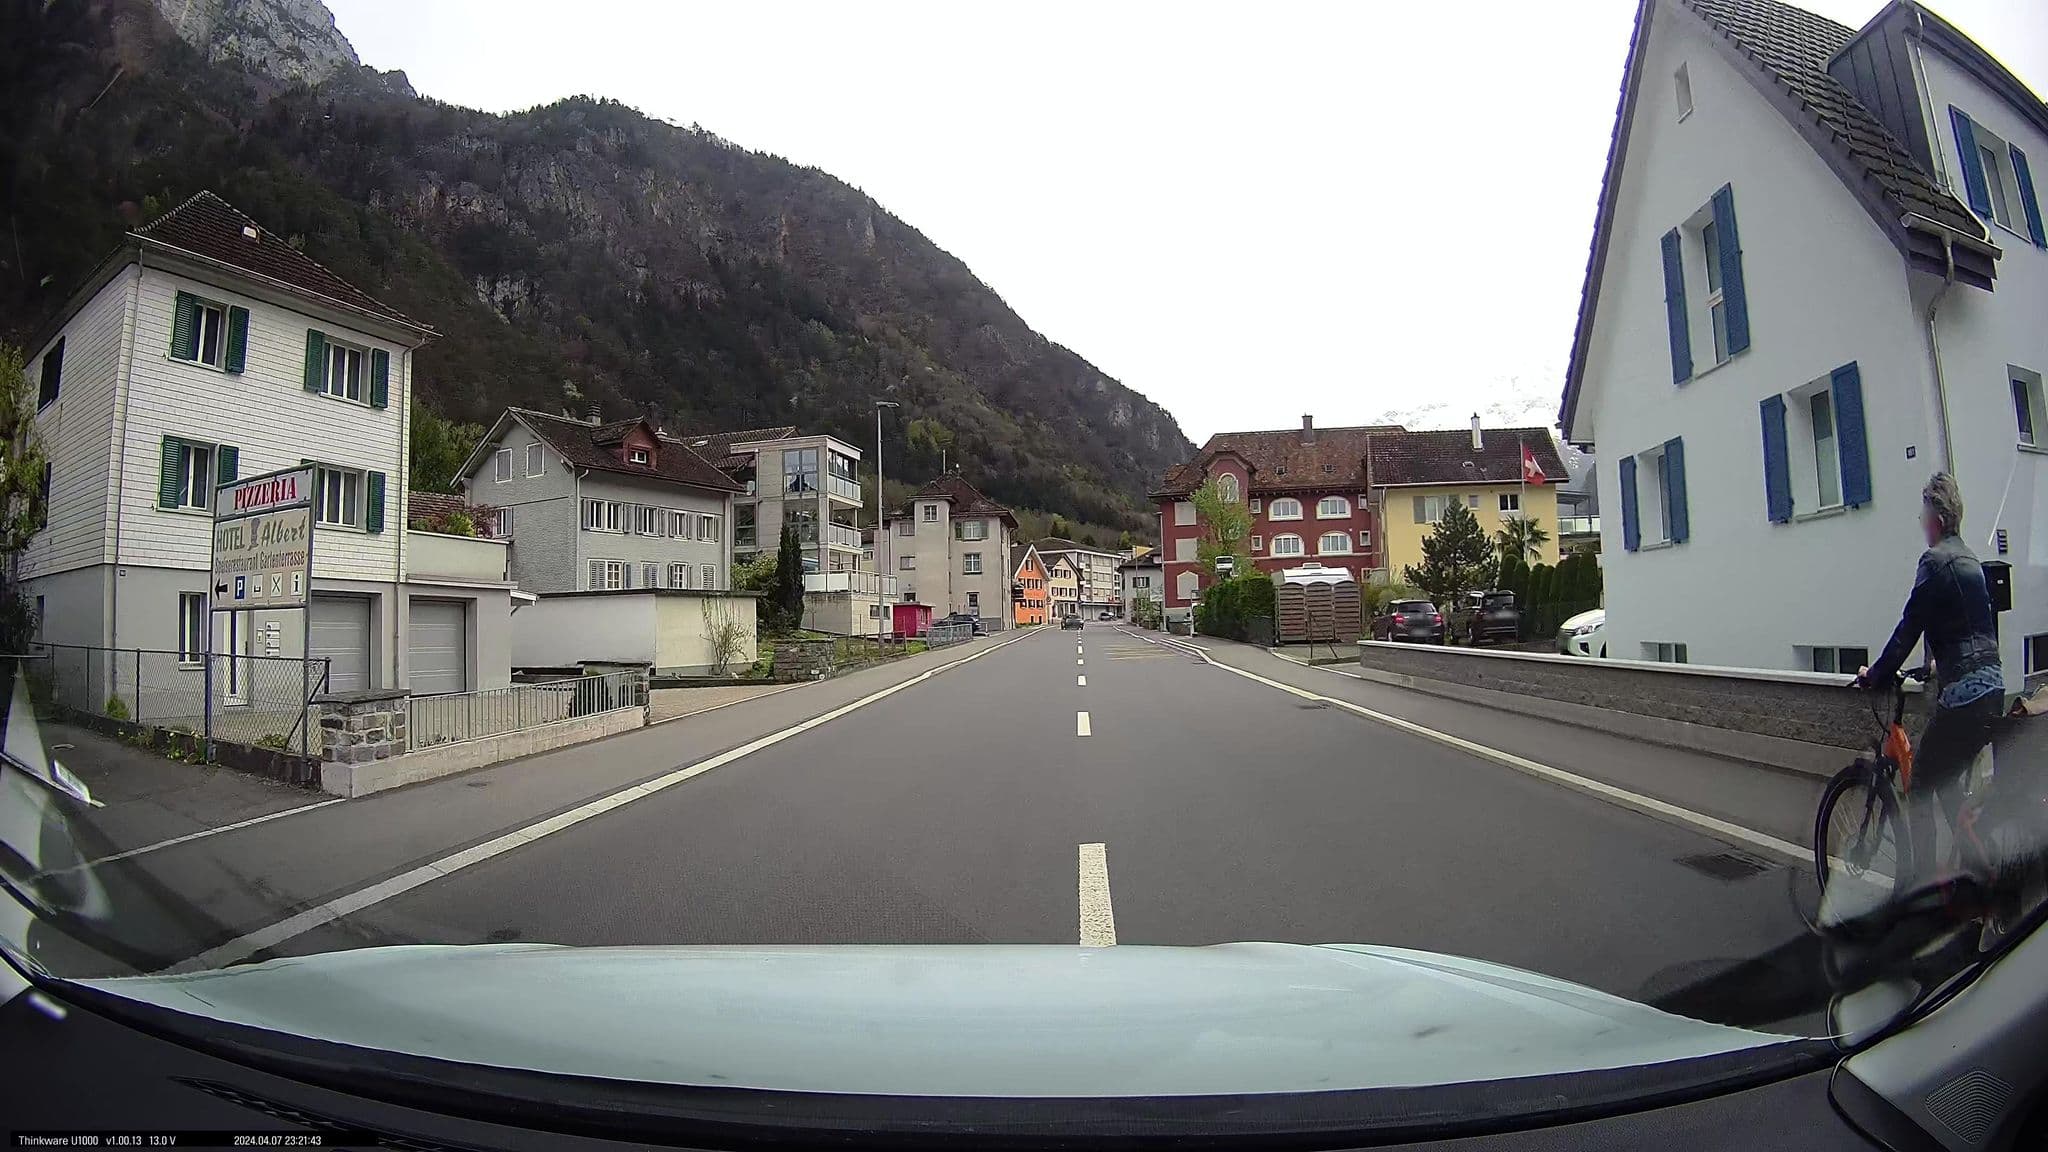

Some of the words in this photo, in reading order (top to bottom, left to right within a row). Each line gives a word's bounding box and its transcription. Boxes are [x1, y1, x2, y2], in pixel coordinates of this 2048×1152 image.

[234, 477, 297, 510] PIZZERIA
[215, 526, 245, 553] HOTEL
[261, 515, 306, 546] Albert
[236, 580, 243, 596] P
